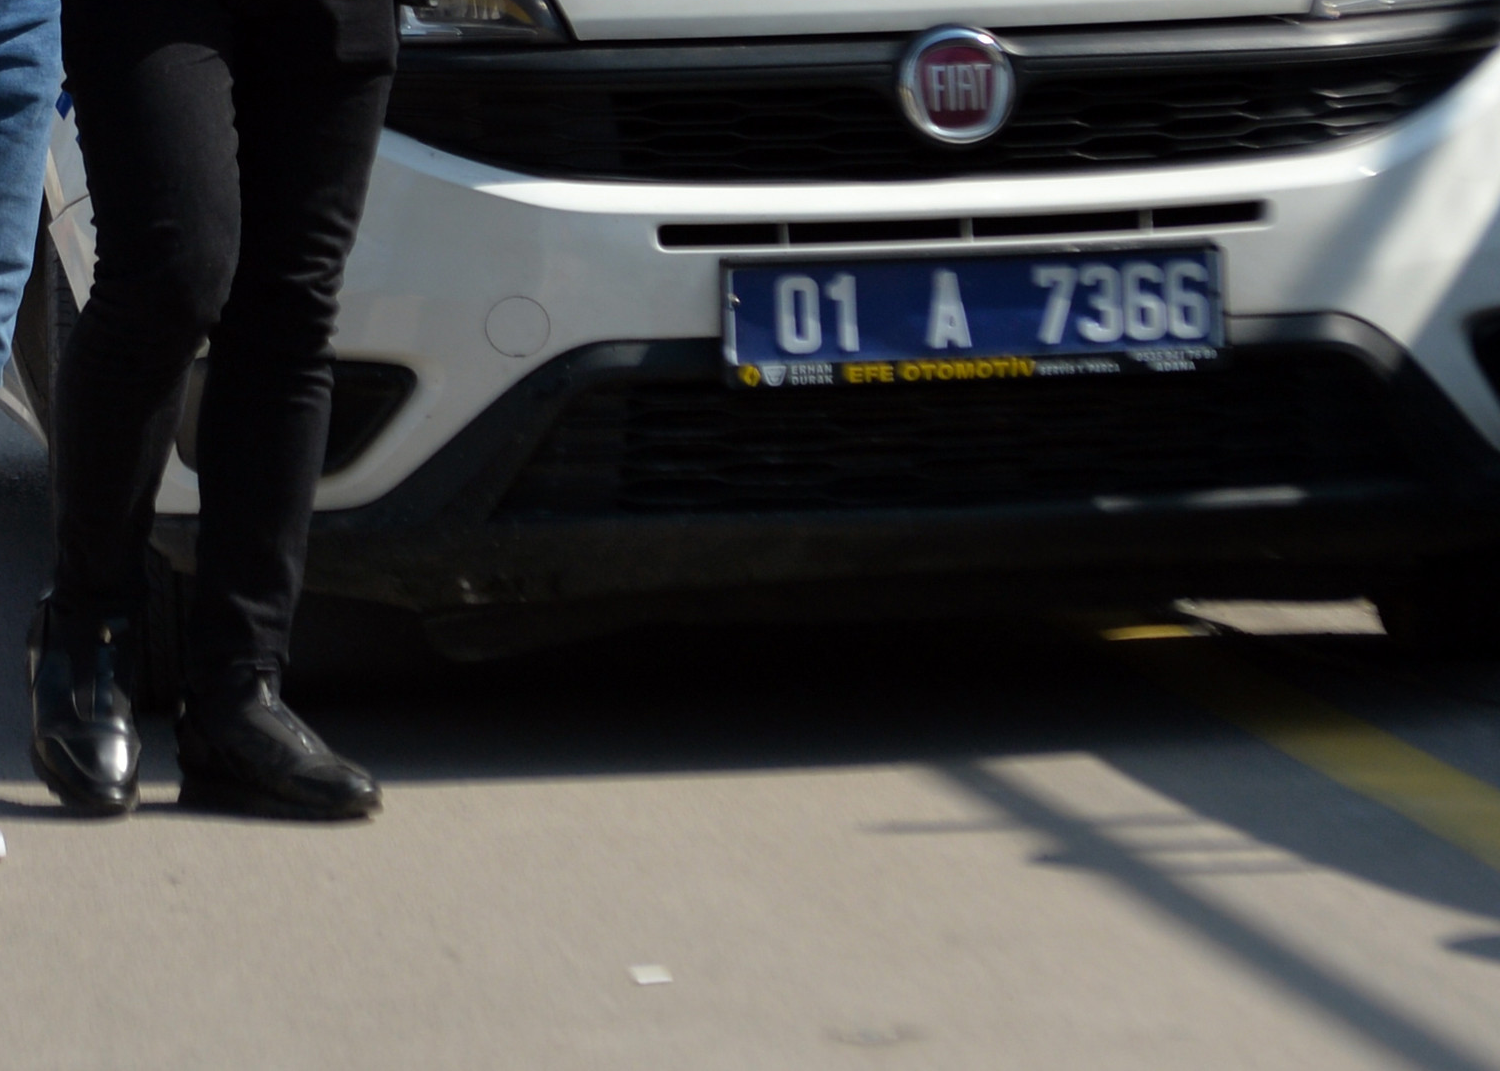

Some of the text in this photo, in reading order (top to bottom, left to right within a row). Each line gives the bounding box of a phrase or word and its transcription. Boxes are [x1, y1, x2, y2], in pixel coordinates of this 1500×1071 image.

[927, 62, 992, 113] FIAT
[772, 259, 1212, 355] 01 A 7366
[790, 363, 834, 375] ERHAN
[845, 356, 1037, 383] EFE OTOMOTİV
